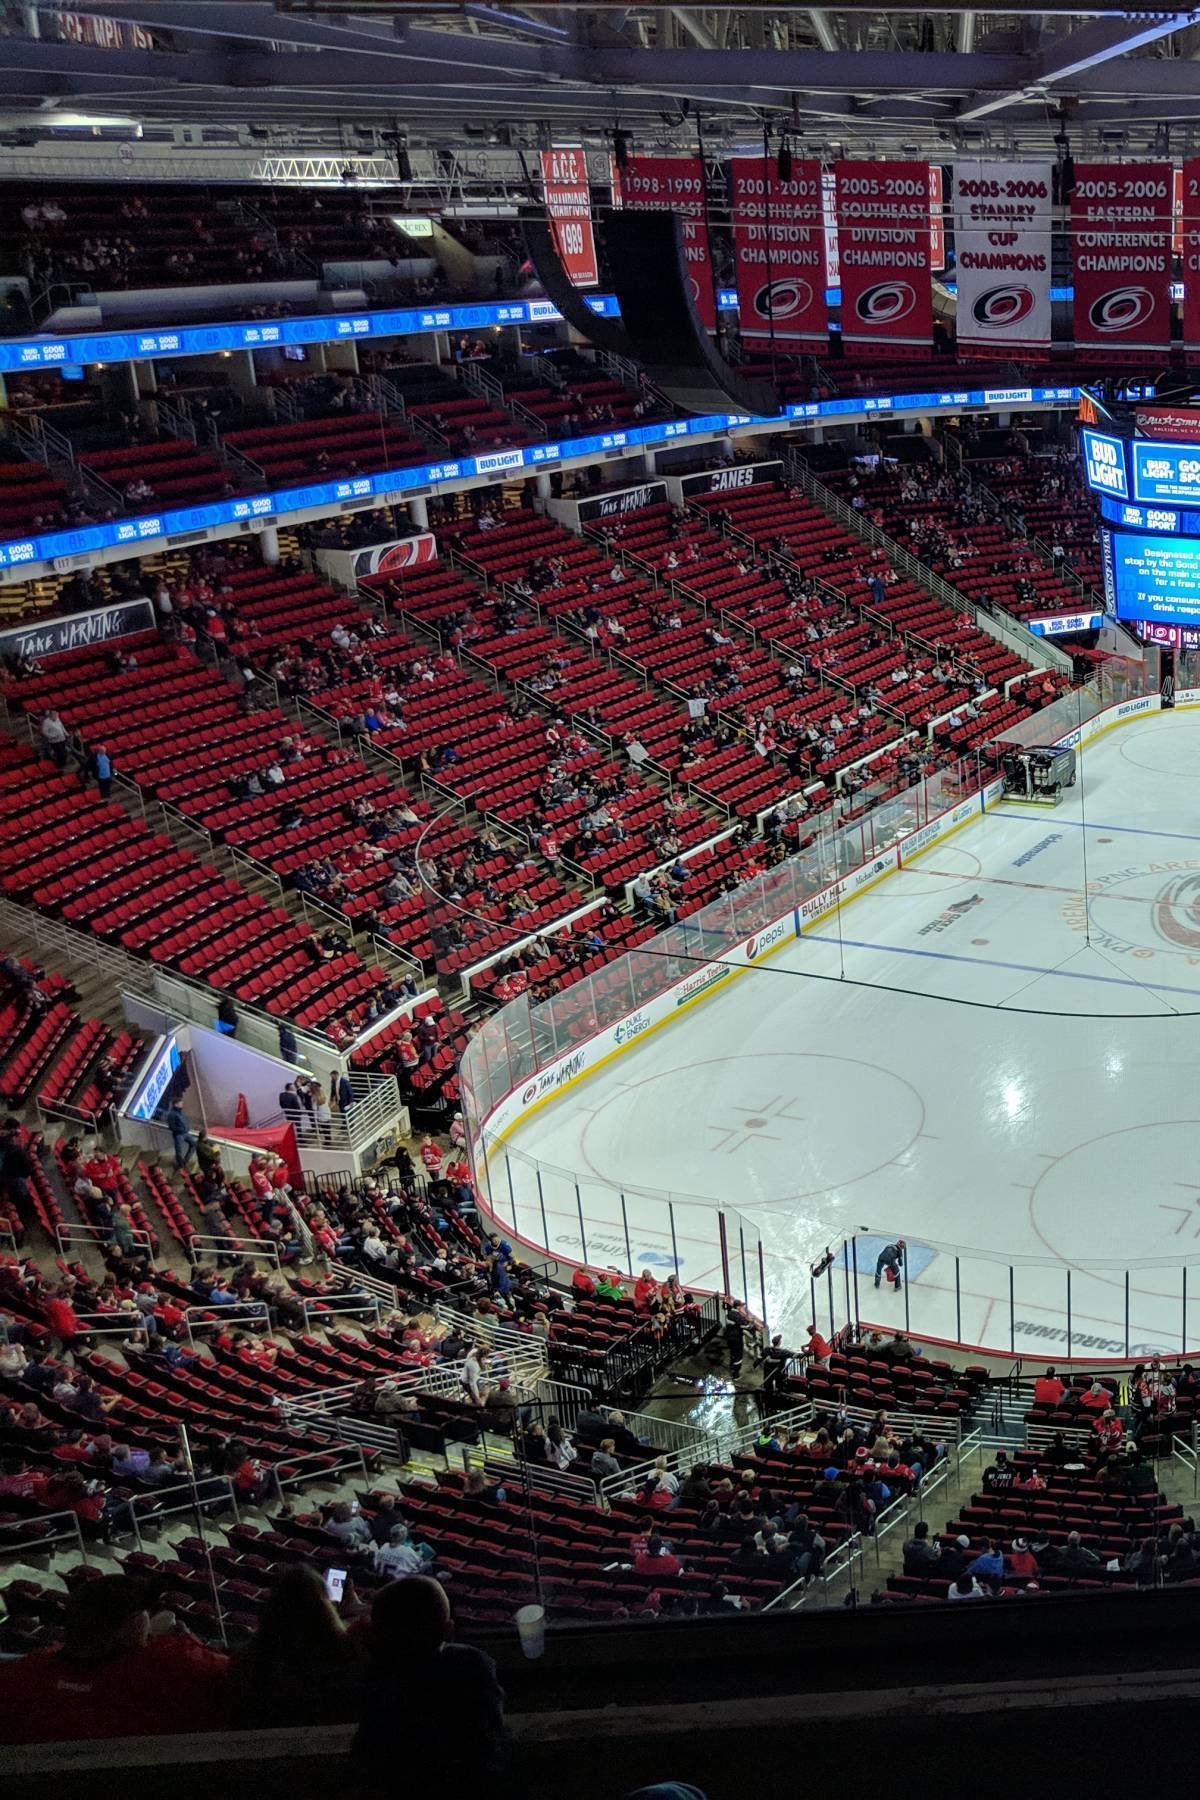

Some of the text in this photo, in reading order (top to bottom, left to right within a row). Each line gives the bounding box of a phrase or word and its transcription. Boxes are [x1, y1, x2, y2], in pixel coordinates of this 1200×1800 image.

[625, 178, 702, 194] 1998-1999
[738, 178, 817, 196] 2001-2002
[841, 178, 925, 196] 2005-2006
[959, 180, 1048, 198] 2005-2006
[1076, 181, 1168, 197] 2005-2006
[739, 202, 817, 219] SOUTHEAST
[841, 202, 926, 219] SOUTHEAST
[970, 204, 1036, 222] STANLEY
[1087, 206, 1155, 222] EASTERN
[561, 224, 583, 254] 1989
[749, 226, 810, 242] DIVISION
[852, 229, 916, 244] DIVISION
[988, 232, 1018, 246] CUP
[1077, 232, 1165, 248] CONFERENCE
[740, 248, 819, 266] CHAMPIONS
[843, 251, 926, 268] CHAMPIONS
[960, 252, 1047, 271] CHAMPIONS
[1077, 255, 1165, 272] CHAMPIONS
[533, 307, 548, 316] BUD
[159, 336, 178, 344] GOOD
[160, 342, 178, 350] SPORT
[43, 345, 65, 354] GOOD
[44, 352, 65, 360] SPORT
[988, 391, 1028, 401] BUD LIGHT
[1175, 419, 1197, 427] STAR
[1091, 439, 1117, 466] BUD
[480, 454, 520, 470] BUD LIGHT
[1146, 460, 1170, 471] BUD
[711, 468, 754, 491] CANES
[1089, 460, 1124, 490] LIGHT
[1142, 468, 1175, 480] LIGHT
[252, 499, 271, 508] GOOD
[1125, 507, 1141, 517] BUD
[1146, 510, 1176, 523] GOOD
[139, 519, 160, 529] GOOD
[1123, 515, 1143, 526] LIGHT
[1146, 520, 1176, 531] SPORT
[118, 530, 137, 539] LIGHT
[140, 527, 161, 536] SPORT
[9, 543, 33, 555] GOOD
[1144, 549, 1194, 561] Designated
[11, 552, 34, 562] SPORT
[58, 558, 70, 568] 117
[1124, 558, 1144, 568] stop
[1146, 558, 1157, 567] by
[1159, 558, 1173, 568] the
[1175, 559, 1198, 569] Good
[1152, 568, 1166, 577] the
[1168, 570, 1190, 578] main
[1155, 578, 1168, 586] for
[1177, 579, 1196, 588] free
[1137, 592, 1146, 600] If
[1147, 594, 1164, 602] you
[1153, 603, 1175, 612] drink
[16, 611, 125, 656] TAKE WARNING
[1169, 629, 1176, 642] 0
[1118, 701, 1150, 716] BUD LIGHT
[855, 867, 874, 887] Michael
[1097, 867, 1147, 885] PNC
[801, 882, 847, 917] BULLY HILL
[1062, 895, 1089, 933] ARENA
[759, 922, 785, 951] pepsi
[683, 976, 706, 995] Harris
[706, 961, 728, 979] Teeter
[625, 1012, 642, 1030] DUKE
[627, 1018, 652, 1039] ENERGY
[1010, 1321, 1126, 1354] CAROLINAS
